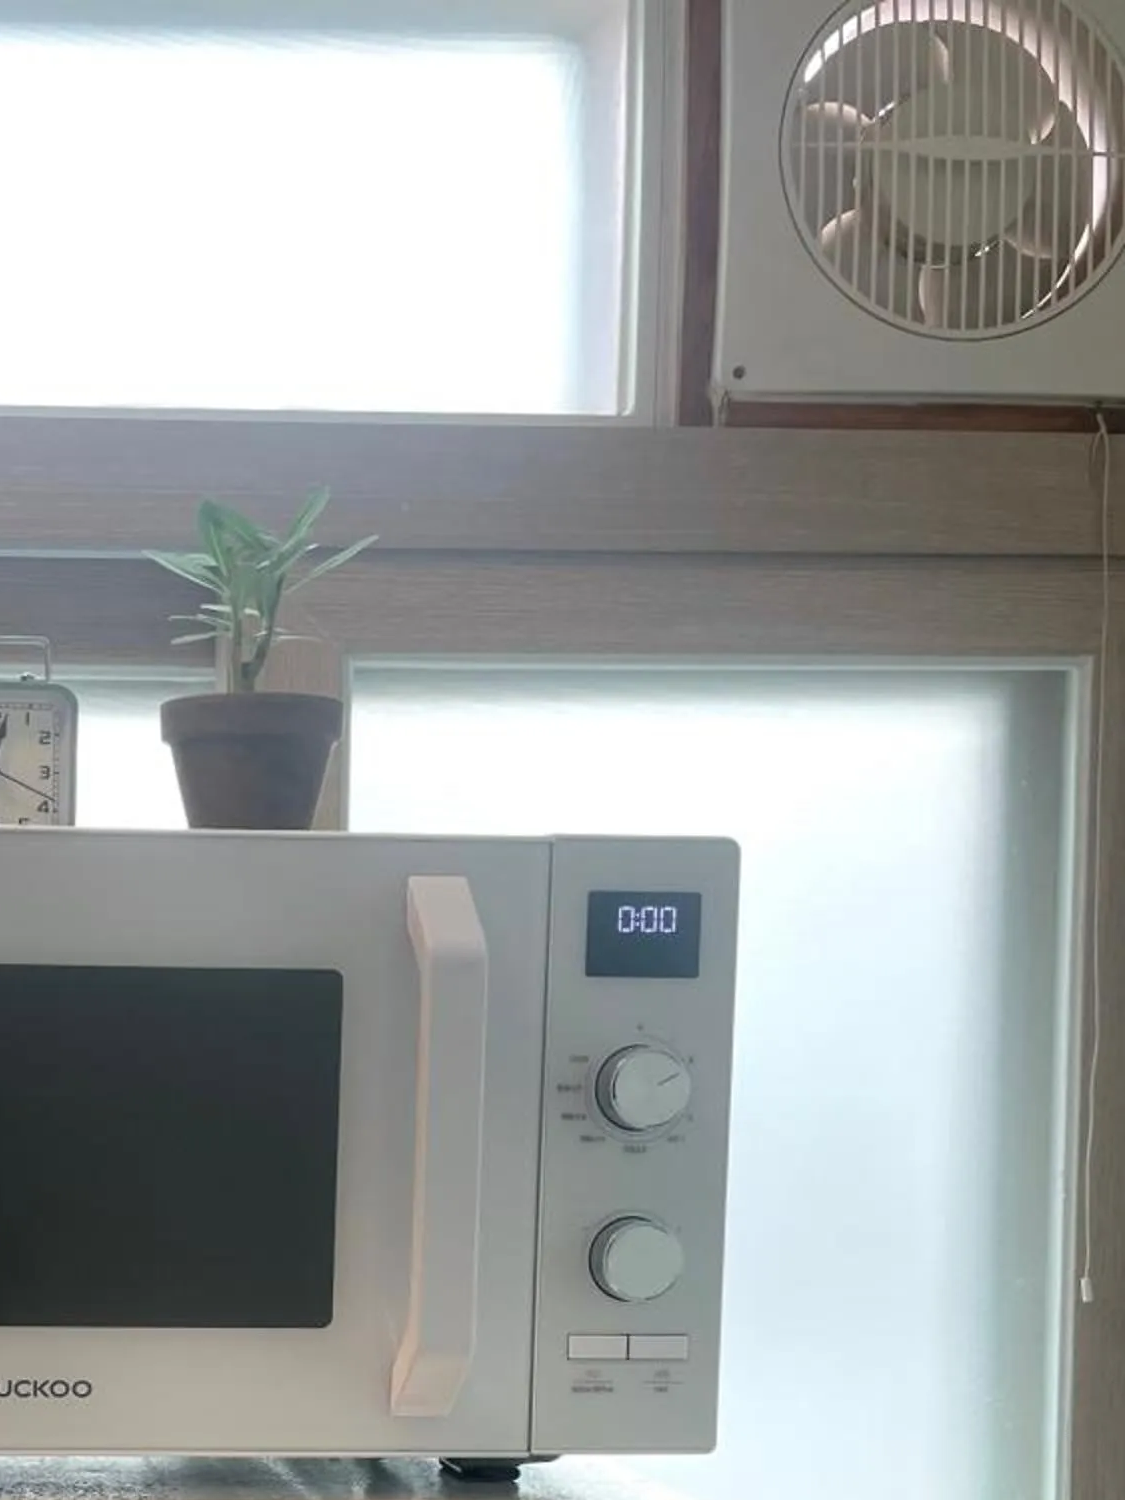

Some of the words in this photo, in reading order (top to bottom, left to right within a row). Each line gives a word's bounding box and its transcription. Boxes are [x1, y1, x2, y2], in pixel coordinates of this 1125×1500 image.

[38, 730, 51, 745] 2
[39, 765, 51, 780] 3
[37, 800, 50, 814] 4
[618, 905, 677, 933] 0:00
